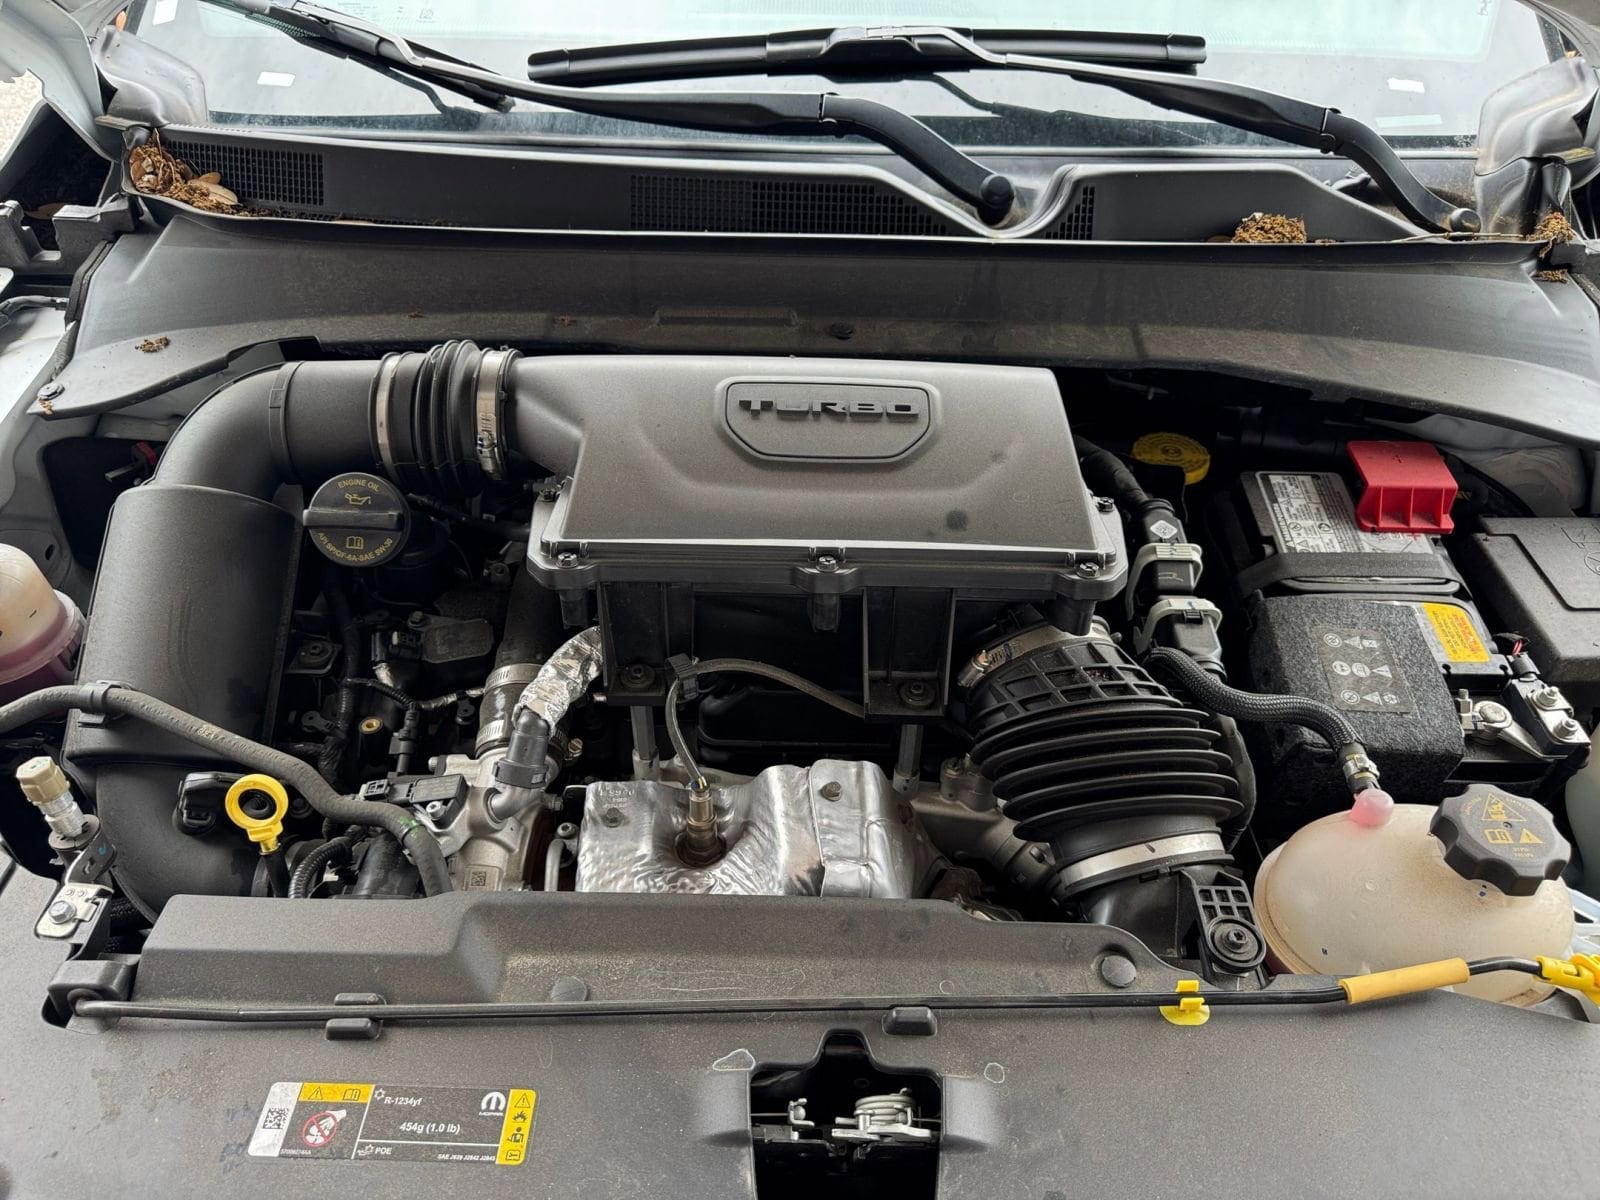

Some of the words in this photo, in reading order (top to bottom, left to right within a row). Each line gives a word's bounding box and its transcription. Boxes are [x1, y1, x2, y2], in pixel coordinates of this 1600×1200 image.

[738, 400, 919, 419] TURBO
[337, 479, 367, 488] ENGINE
[367, 481, 381, 492] OIL
[384, 1096, 422, 1107] R-1234yf
[400, 1122, 424, 1133] 454g
[425, 1123, 445, 1134] (1.0
[447, 1124, 461, 1135] lb)
[374, 1147, 392, 1155] POE
